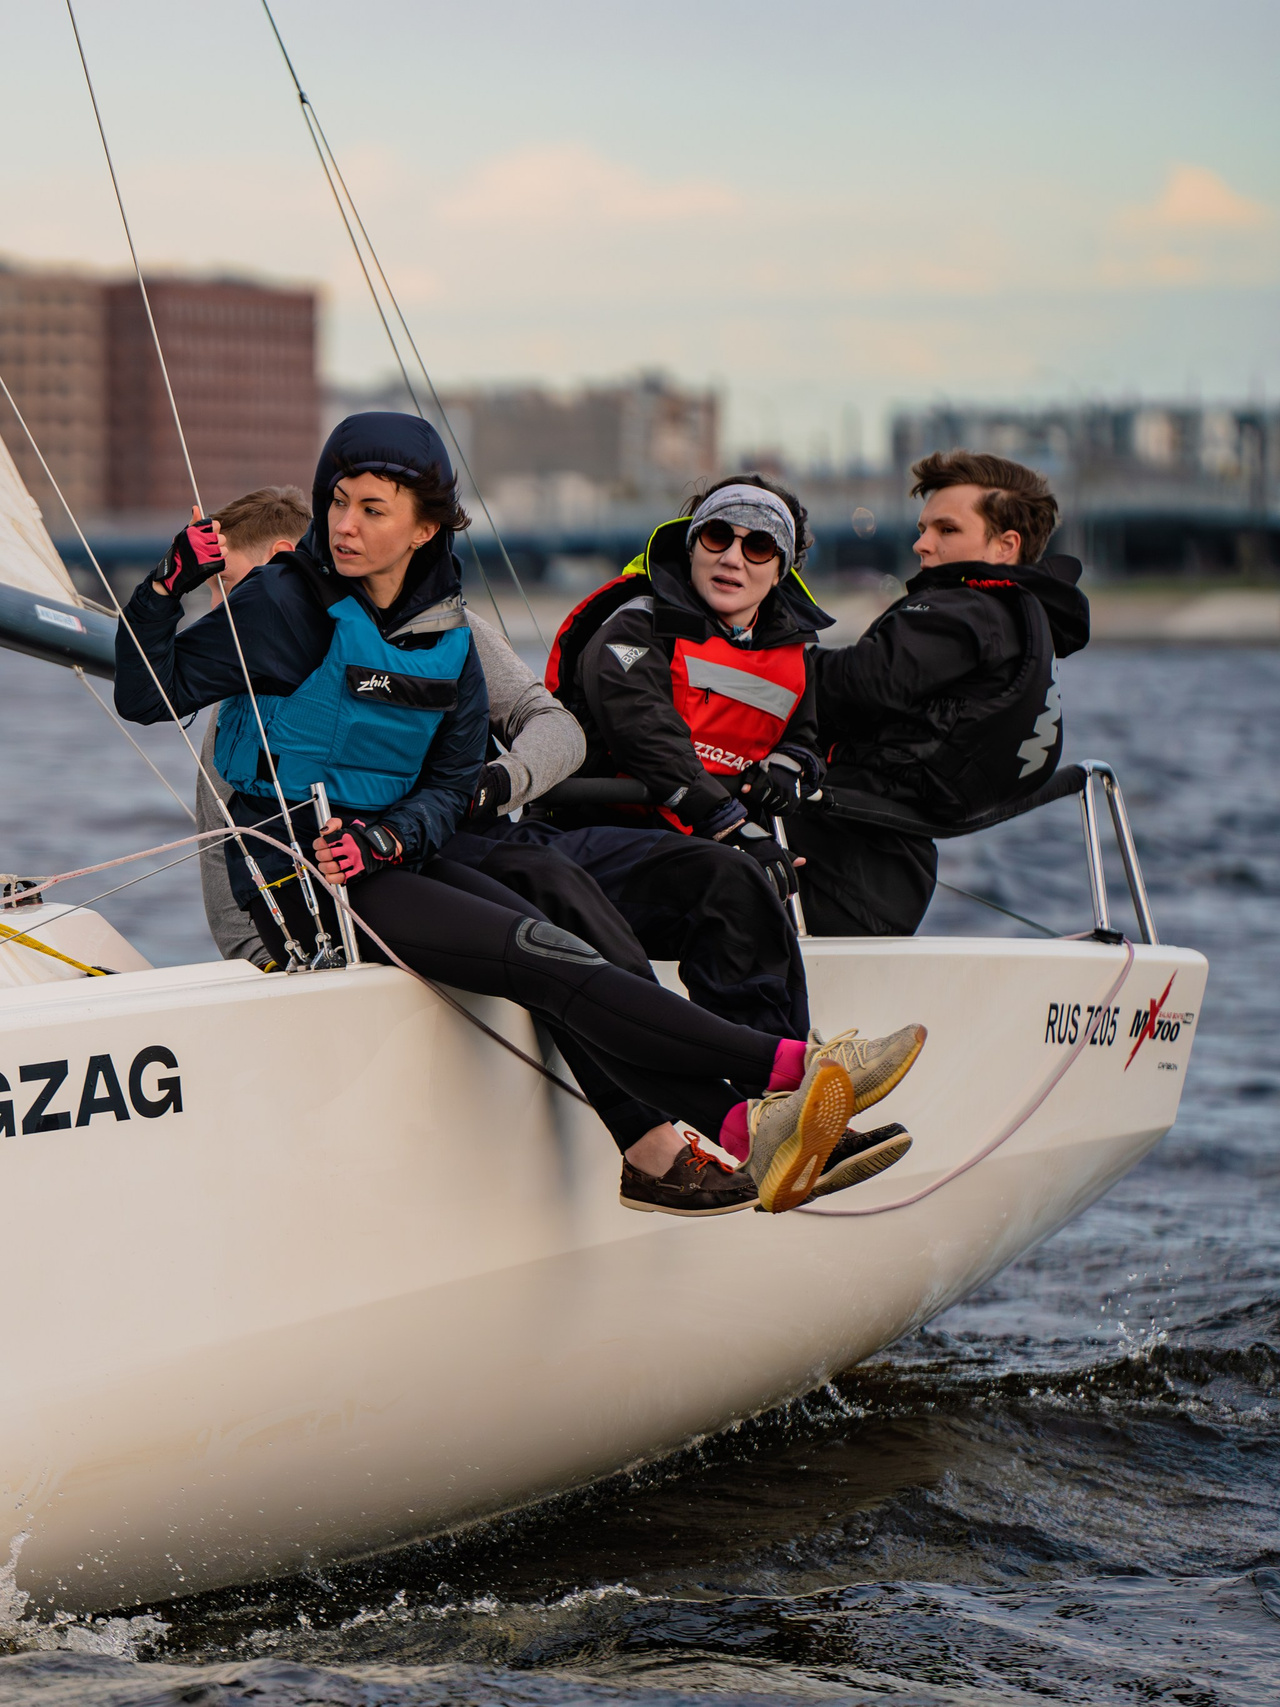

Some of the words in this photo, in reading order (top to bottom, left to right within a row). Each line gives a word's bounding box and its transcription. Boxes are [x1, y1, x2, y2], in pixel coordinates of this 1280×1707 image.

[621, 647, 644, 665] BR2
[356, 674, 392, 693] zhik
[1044, 1002, 1082, 1046] RUS
[1084, 1004, 1121, 1047] 7205
